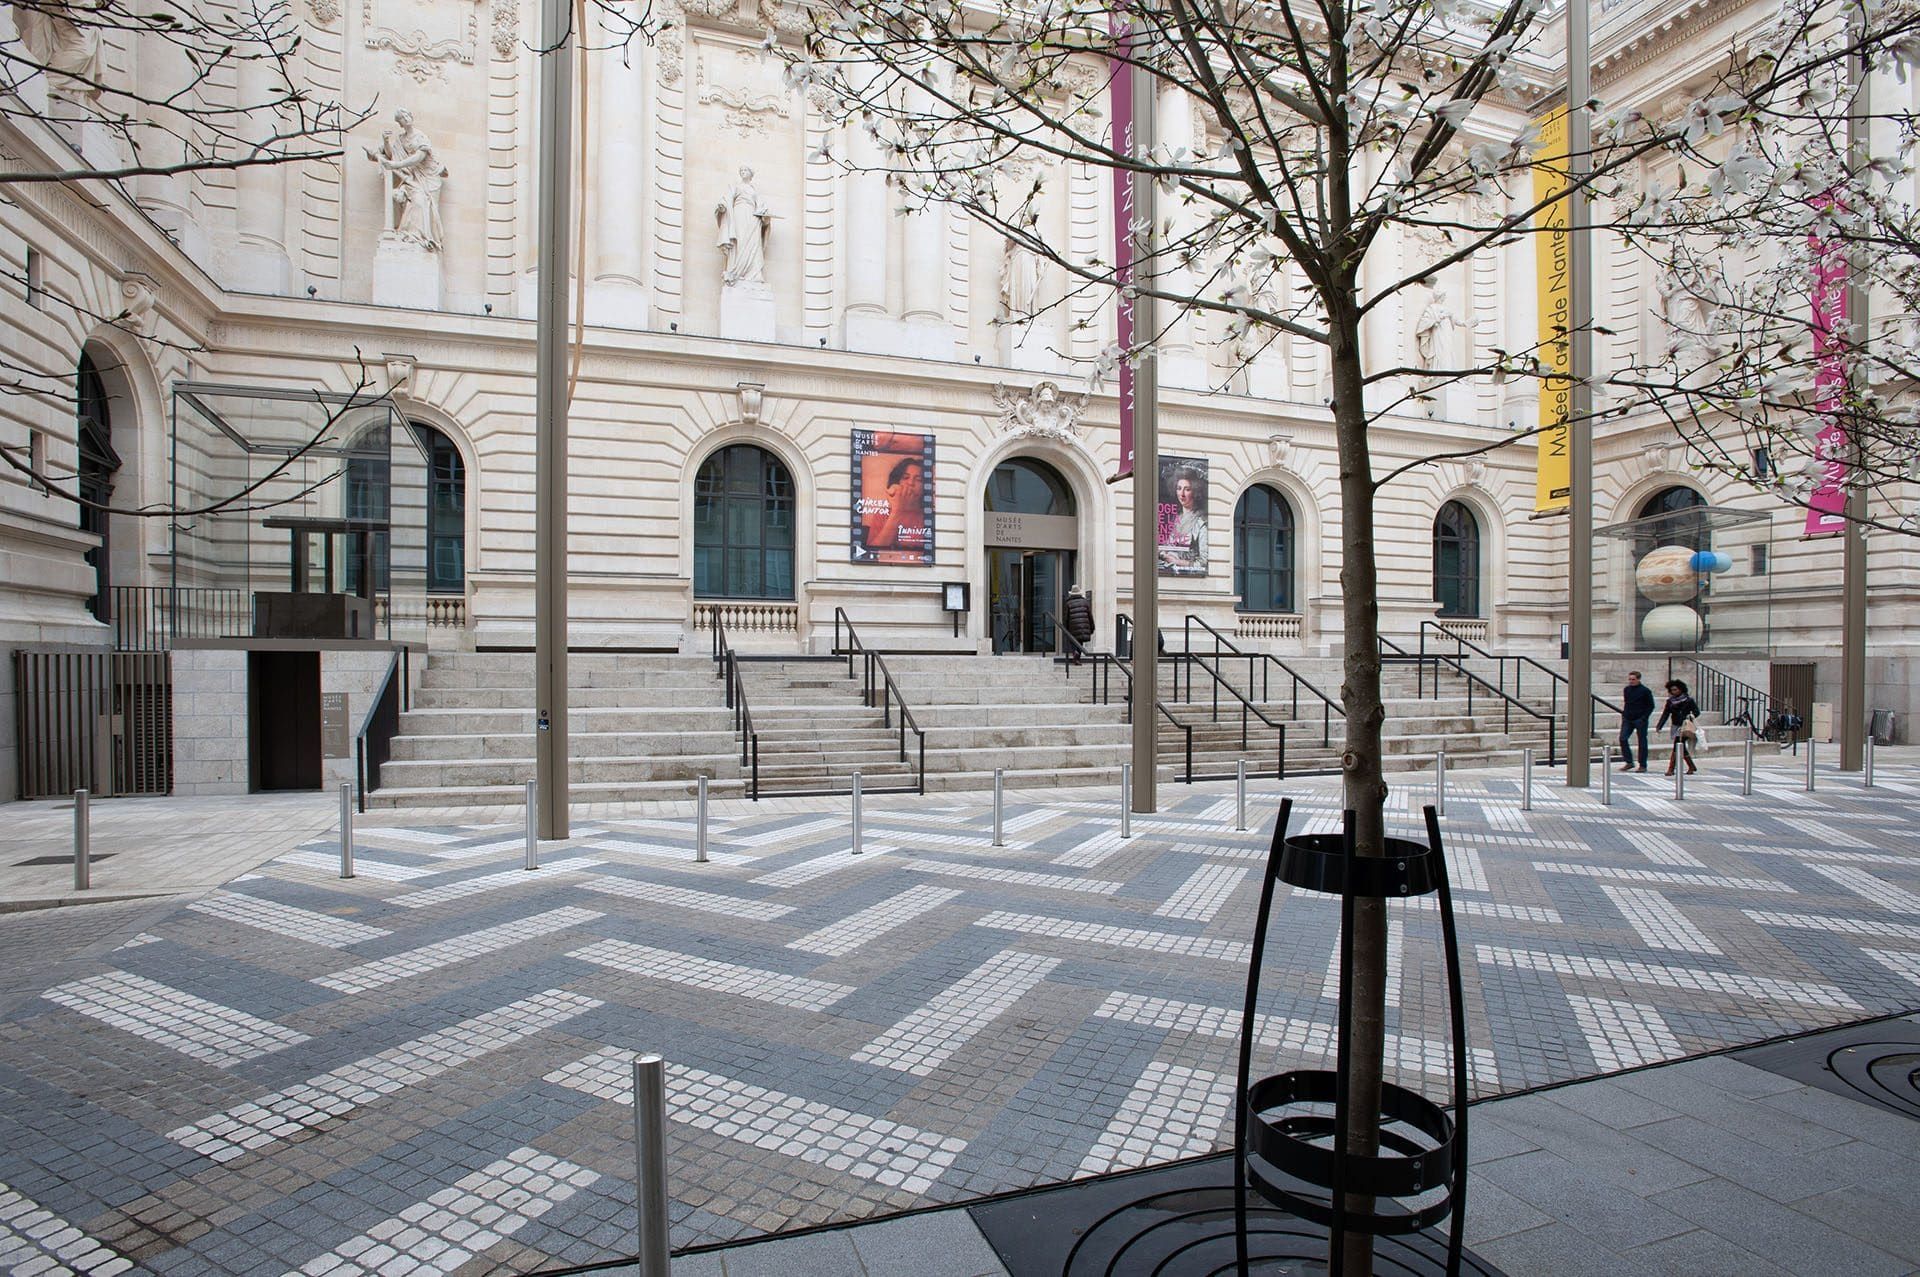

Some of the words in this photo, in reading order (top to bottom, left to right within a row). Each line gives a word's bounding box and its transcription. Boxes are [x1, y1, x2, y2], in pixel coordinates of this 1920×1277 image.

[1548, 218, 1567, 294] Nantes
[1548, 297, 1568, 323] de
[856, 505, 890, 516] CANTOR
[996, 522, 1022, 530] D'ARTS
